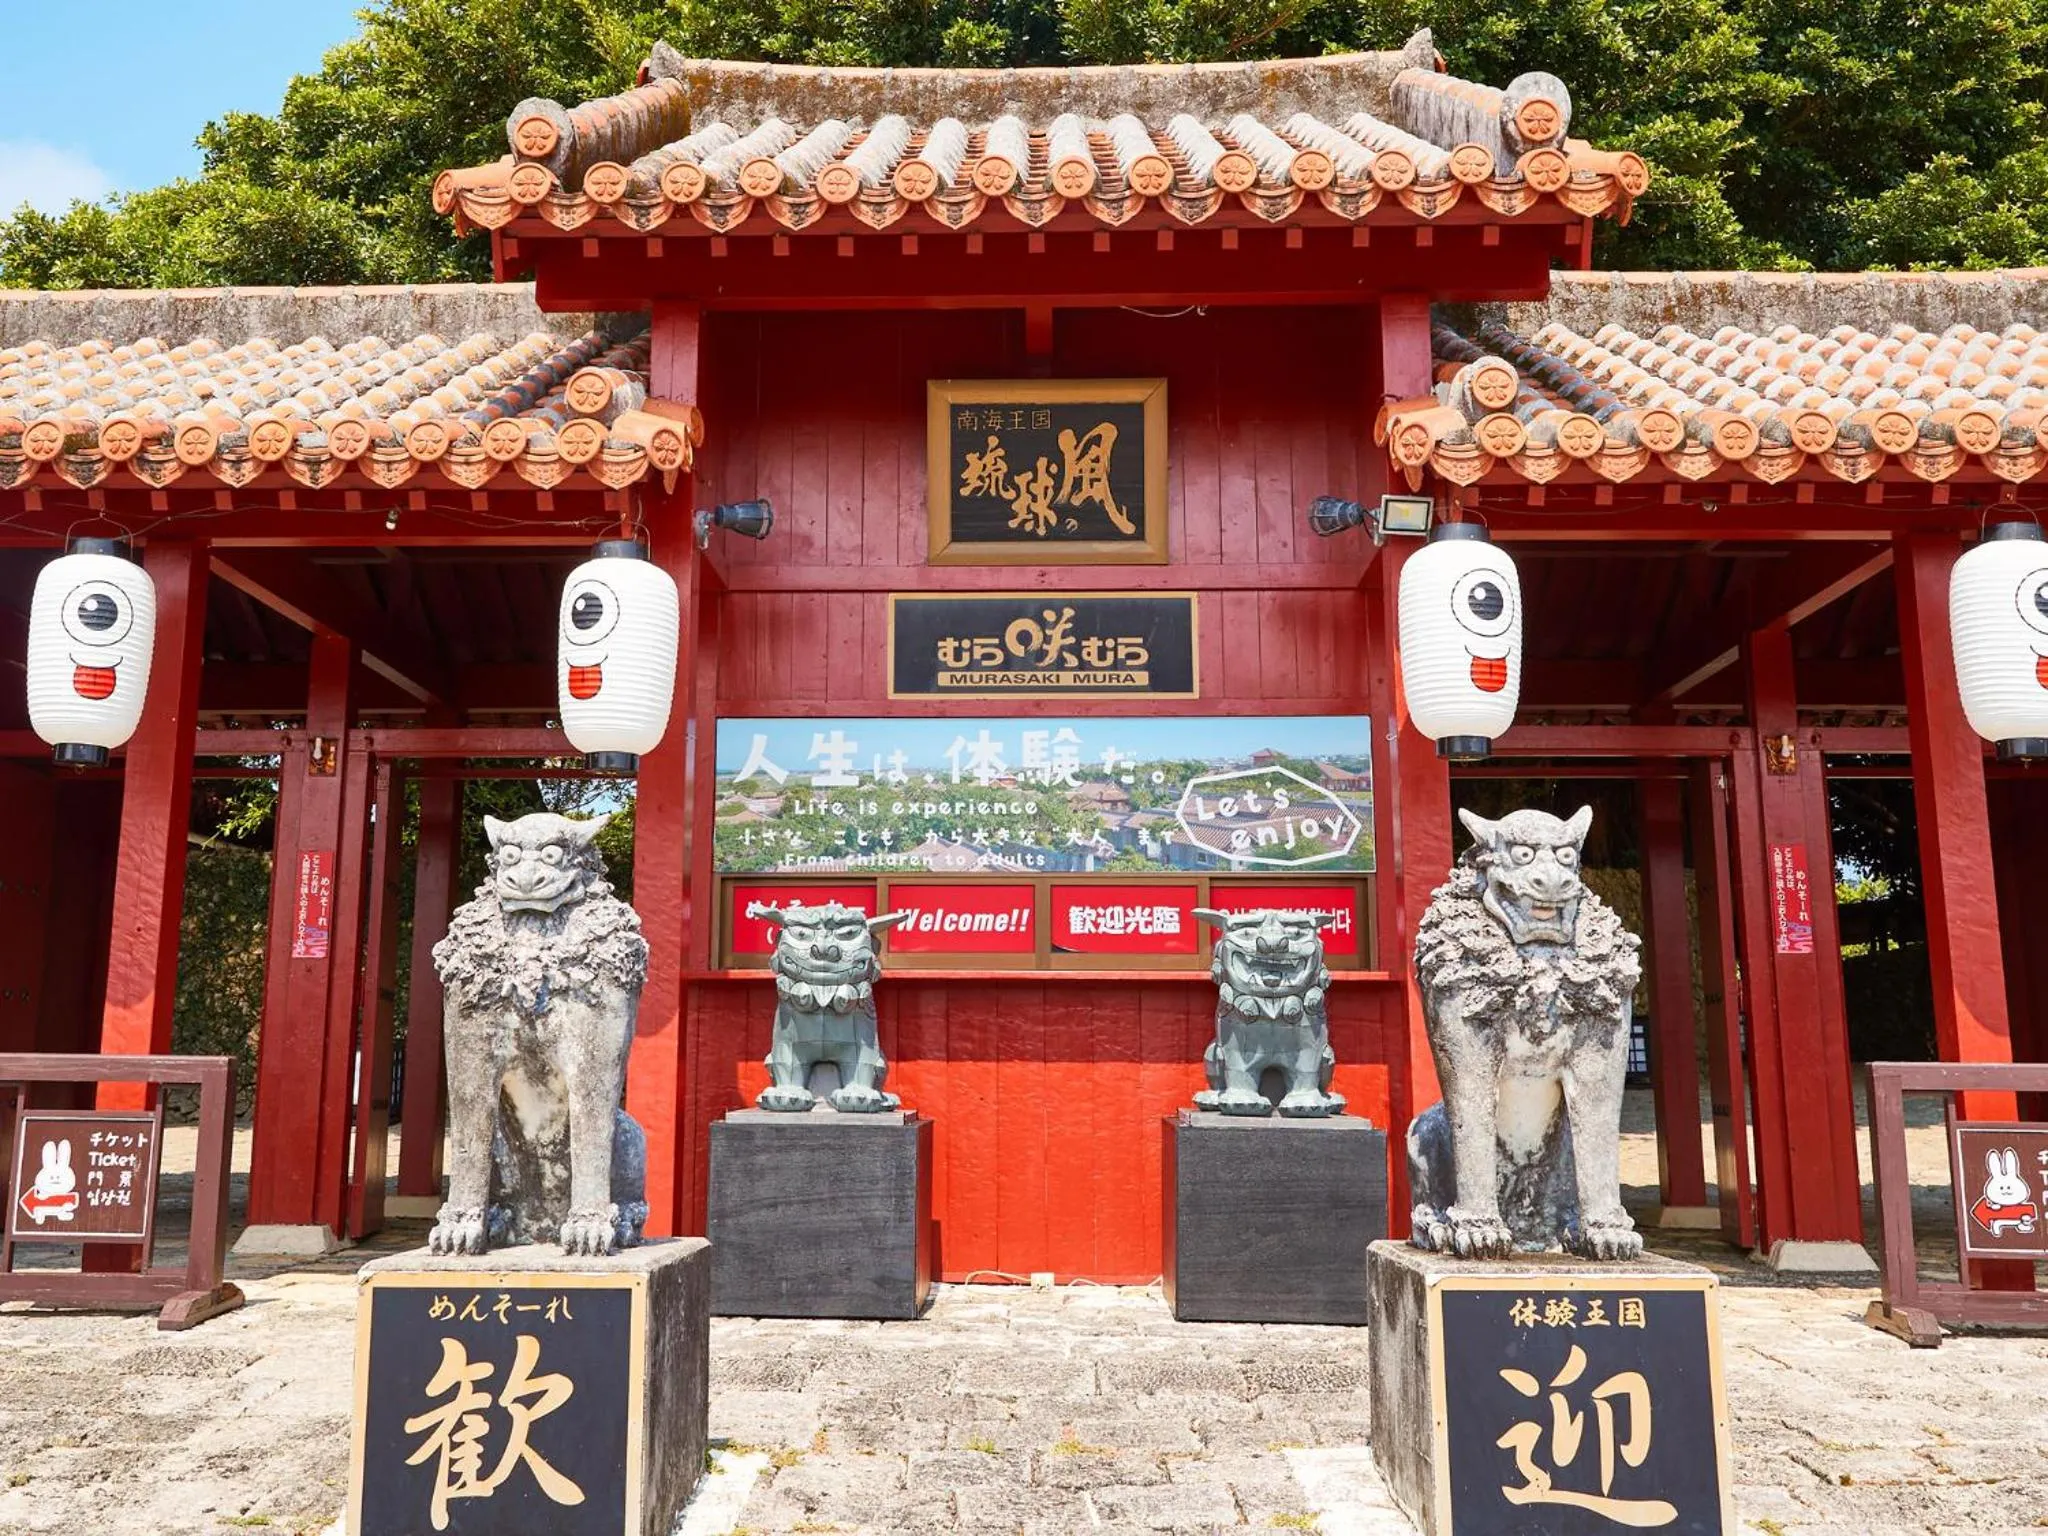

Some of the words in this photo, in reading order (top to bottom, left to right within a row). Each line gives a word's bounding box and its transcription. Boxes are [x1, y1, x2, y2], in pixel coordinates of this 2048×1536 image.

[957, 410, 1050, 431] 南海王国
[950, 673, 1060, 685] MURASAKI
[1073, 673, 1136, 685] MURA
[794, 799, 845, 816] Life
[859, 799, 879, 816] is
[891, 801, 1038, 820] experience
[1195, 780, 1291, 821] Let's
[1231, 814, 1345, 850] enjoy
[785, 853, 834, 867] From
[845, 853, 934, 867] children
[945, 855, 966, 866] to
[977, 852, 1047, 867] adults
[318, 876, 330, 926] めんそーれ
[1795, 870, 1809, 922] めんそーれ
[897, 908, 1030, 932] Welcome!!
[90, 1131, 148, 1148] チケット
[88, 1151, 137, 1167] Ticket
[429, 1294, 573, 1324] めんそーれ
[1509, 1297, 1646, 1329] 体験王国
[1496, 1344, 1679, 1527] 迎
